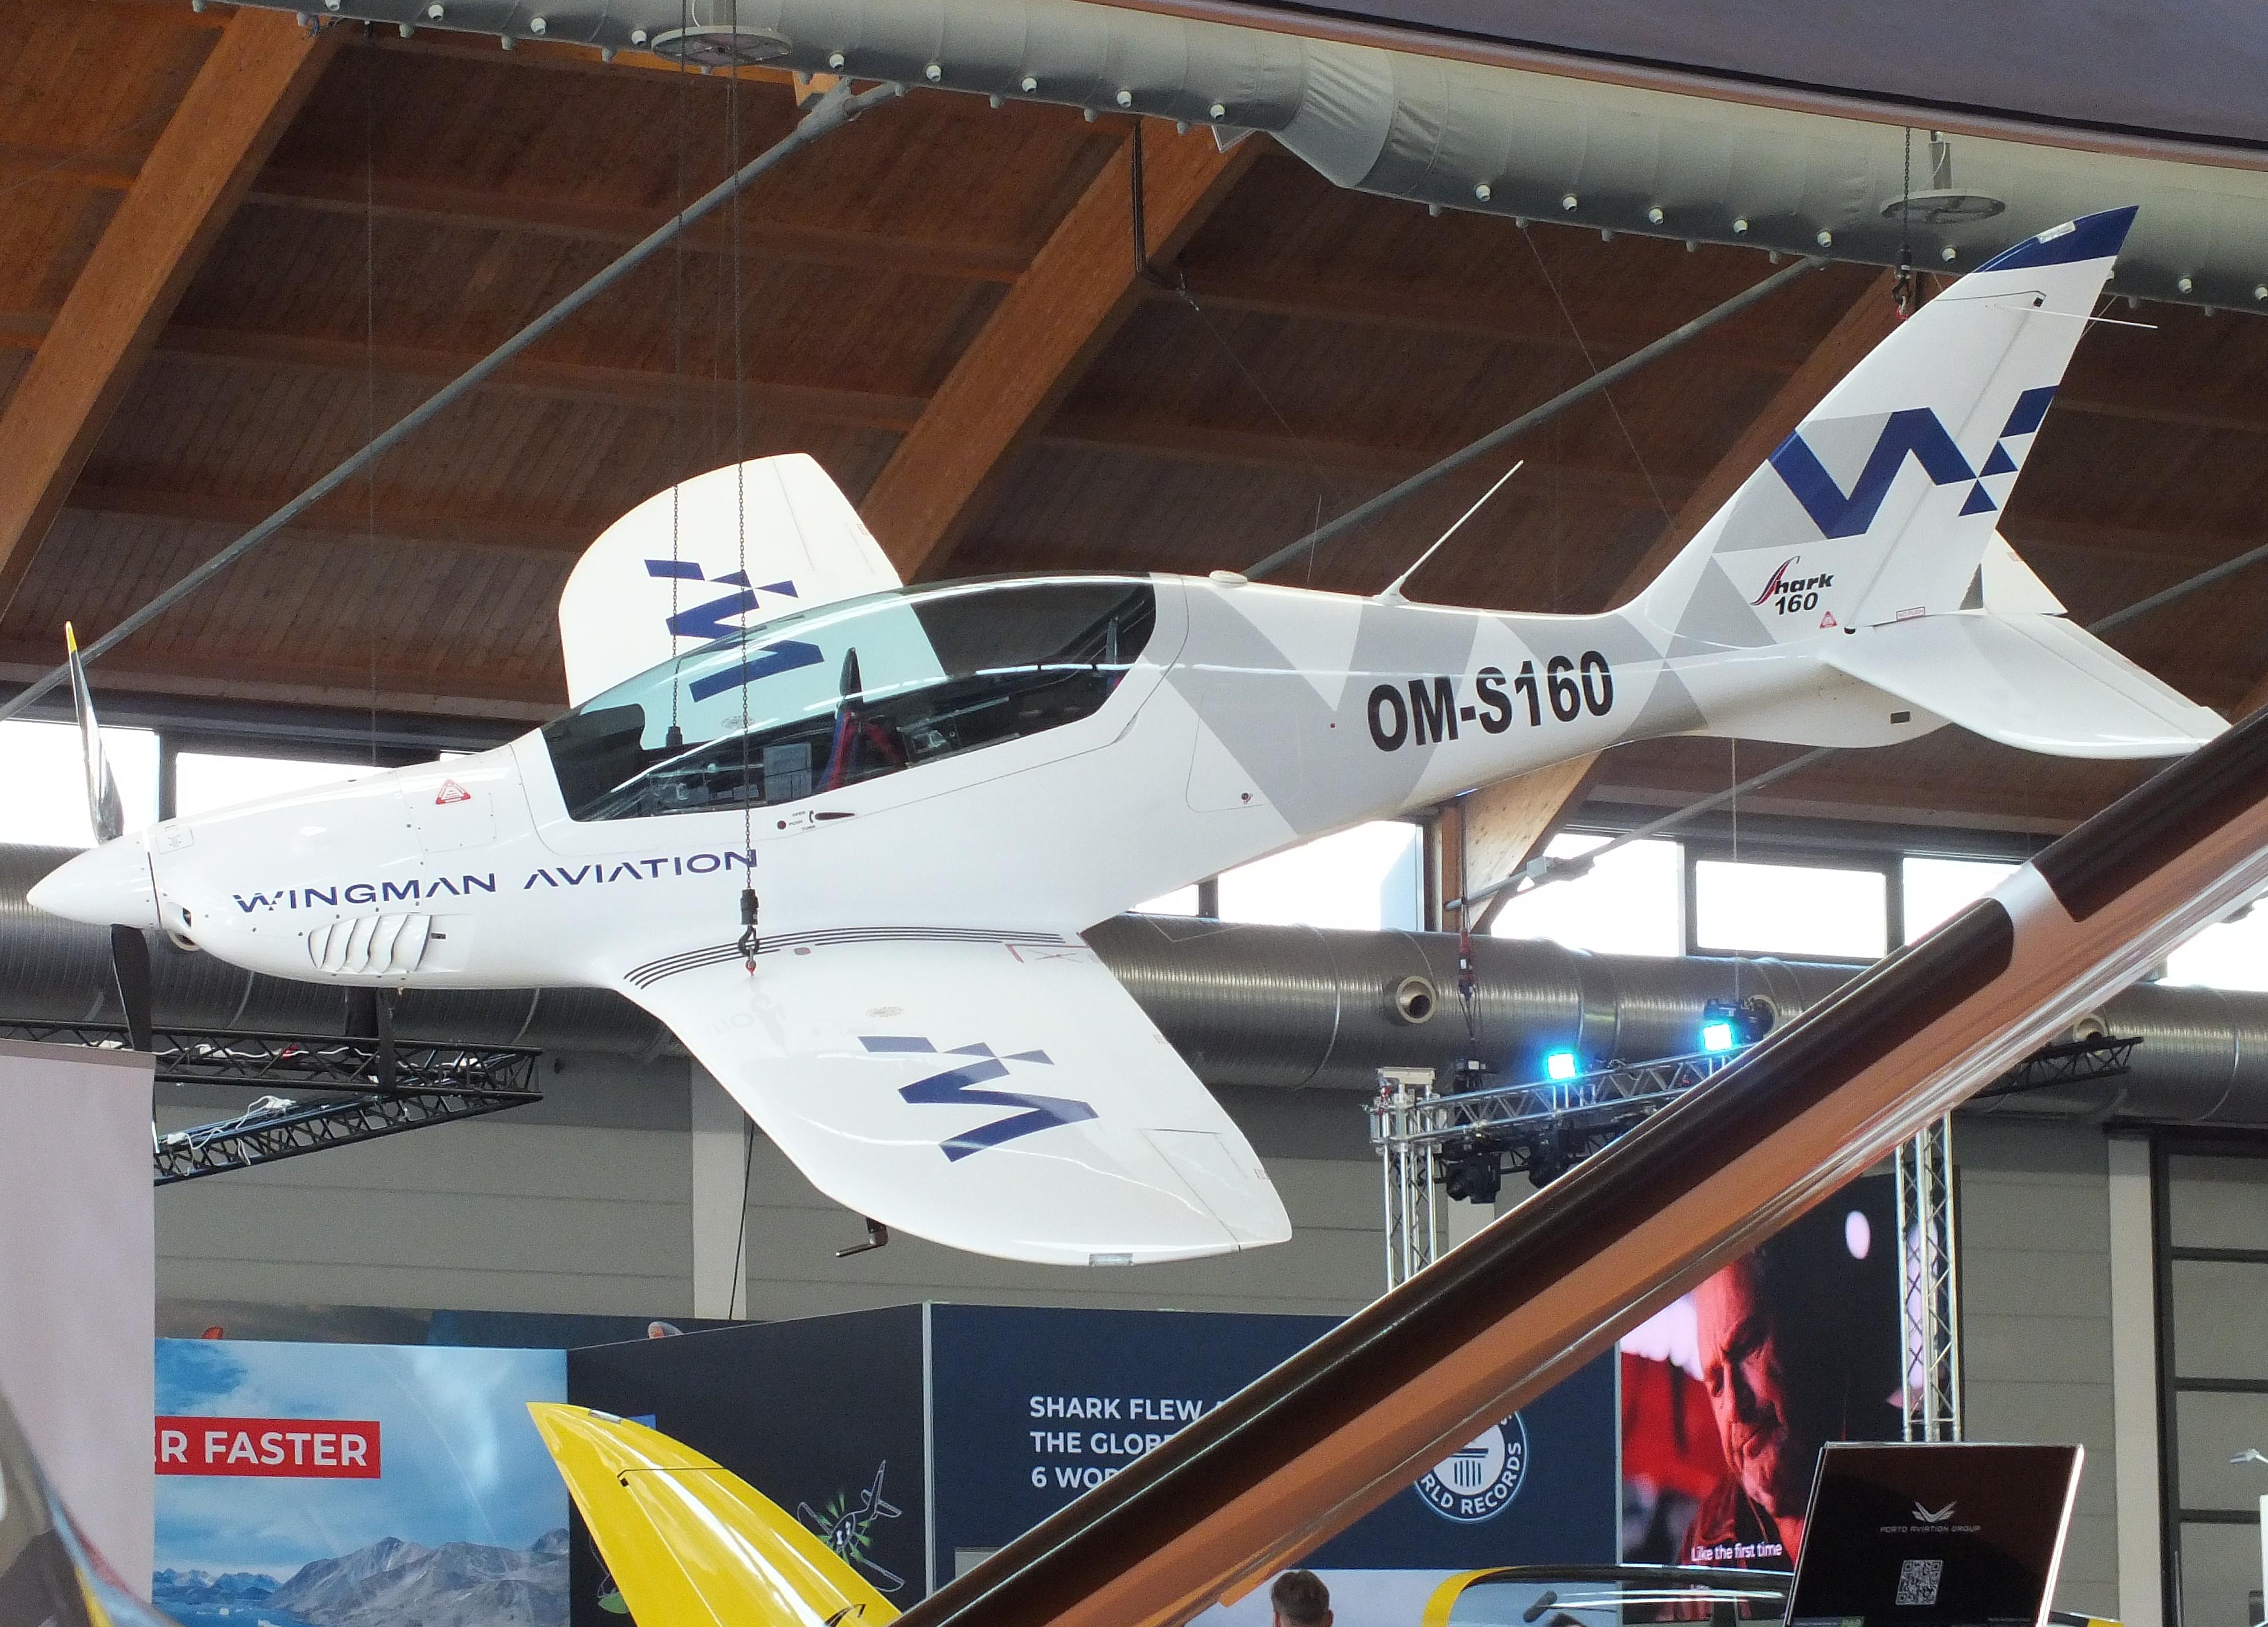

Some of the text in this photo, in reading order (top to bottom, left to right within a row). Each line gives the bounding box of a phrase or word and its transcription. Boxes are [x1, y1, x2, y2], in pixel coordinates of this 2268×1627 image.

[1750, 556, 1834, 606] Shark
[1775, 592, 1818, 615] 160
[1367, 650, 1614, 752] OM-S160
[233, 849, 758, 913] WINGMAN AVIATION
[1030, 1396, 1203, 1421] SHARK FLEW
[155, 1429, 367, 1467] R FASTER
[1030, 1431, 1174, 1455] THE GLOB
[1032, 1466, 1047, 1488] 6
[1421, 1442, 1521, 1514] RLD RECORDS
[1691, 1542, 1783, 1561] Like the first time
